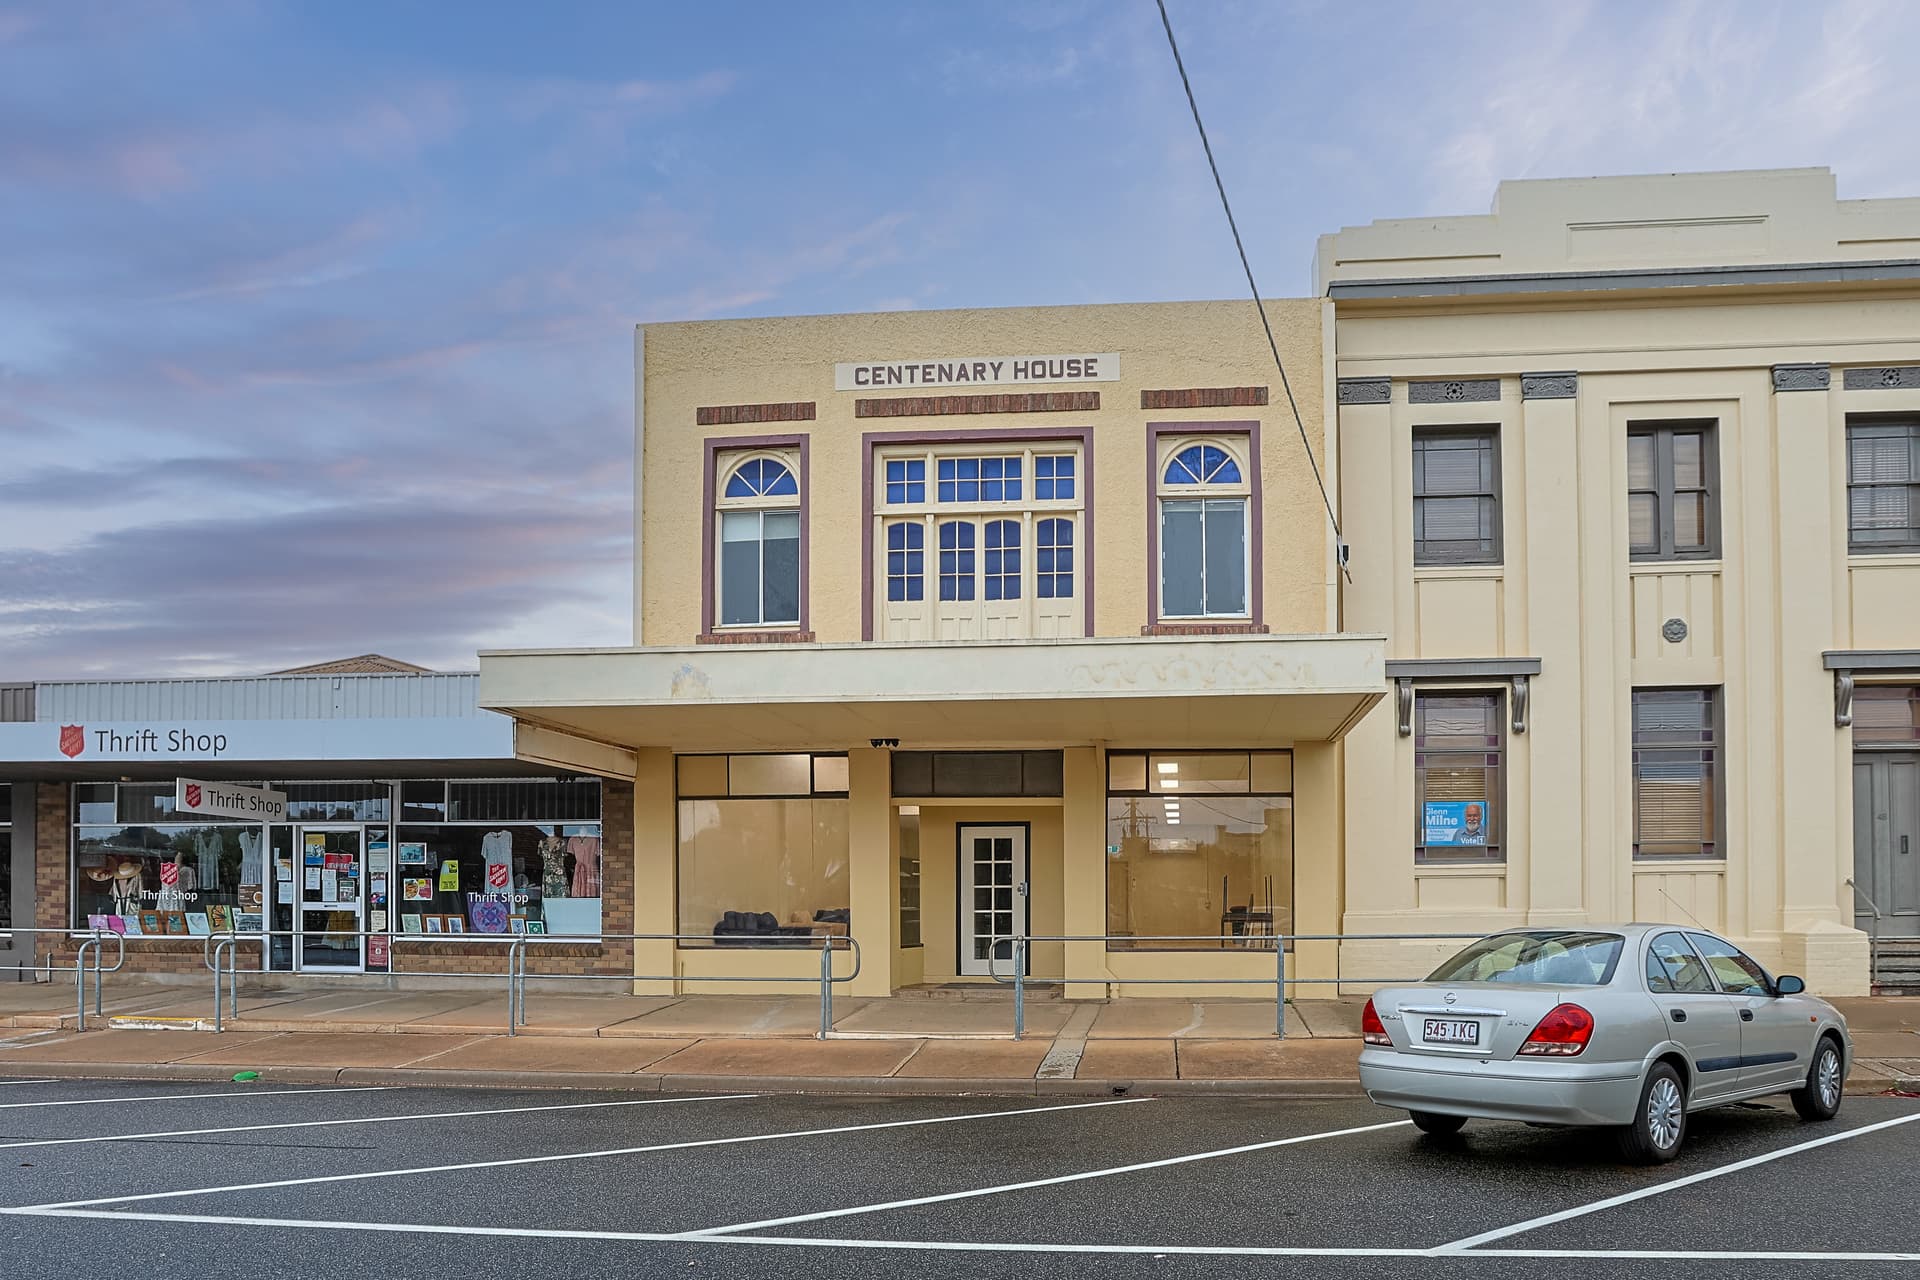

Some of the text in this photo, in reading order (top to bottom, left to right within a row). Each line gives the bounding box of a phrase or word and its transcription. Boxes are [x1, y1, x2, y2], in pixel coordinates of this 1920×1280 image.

[854, 358, 1099, 386] CENTENARY HOUSE
[94, 728, 227, 757] Thrift Shop
[207, 790, 245, 810] Thrift
[249, 795, 282, 817] Shop
[1426, 815, 1458, 825] Milne
[1460, 837, 1477, 845] Vote
[142, 889, 198, 903] Thrift Shop
[468, 892, 529, 905] Thrift Shop
